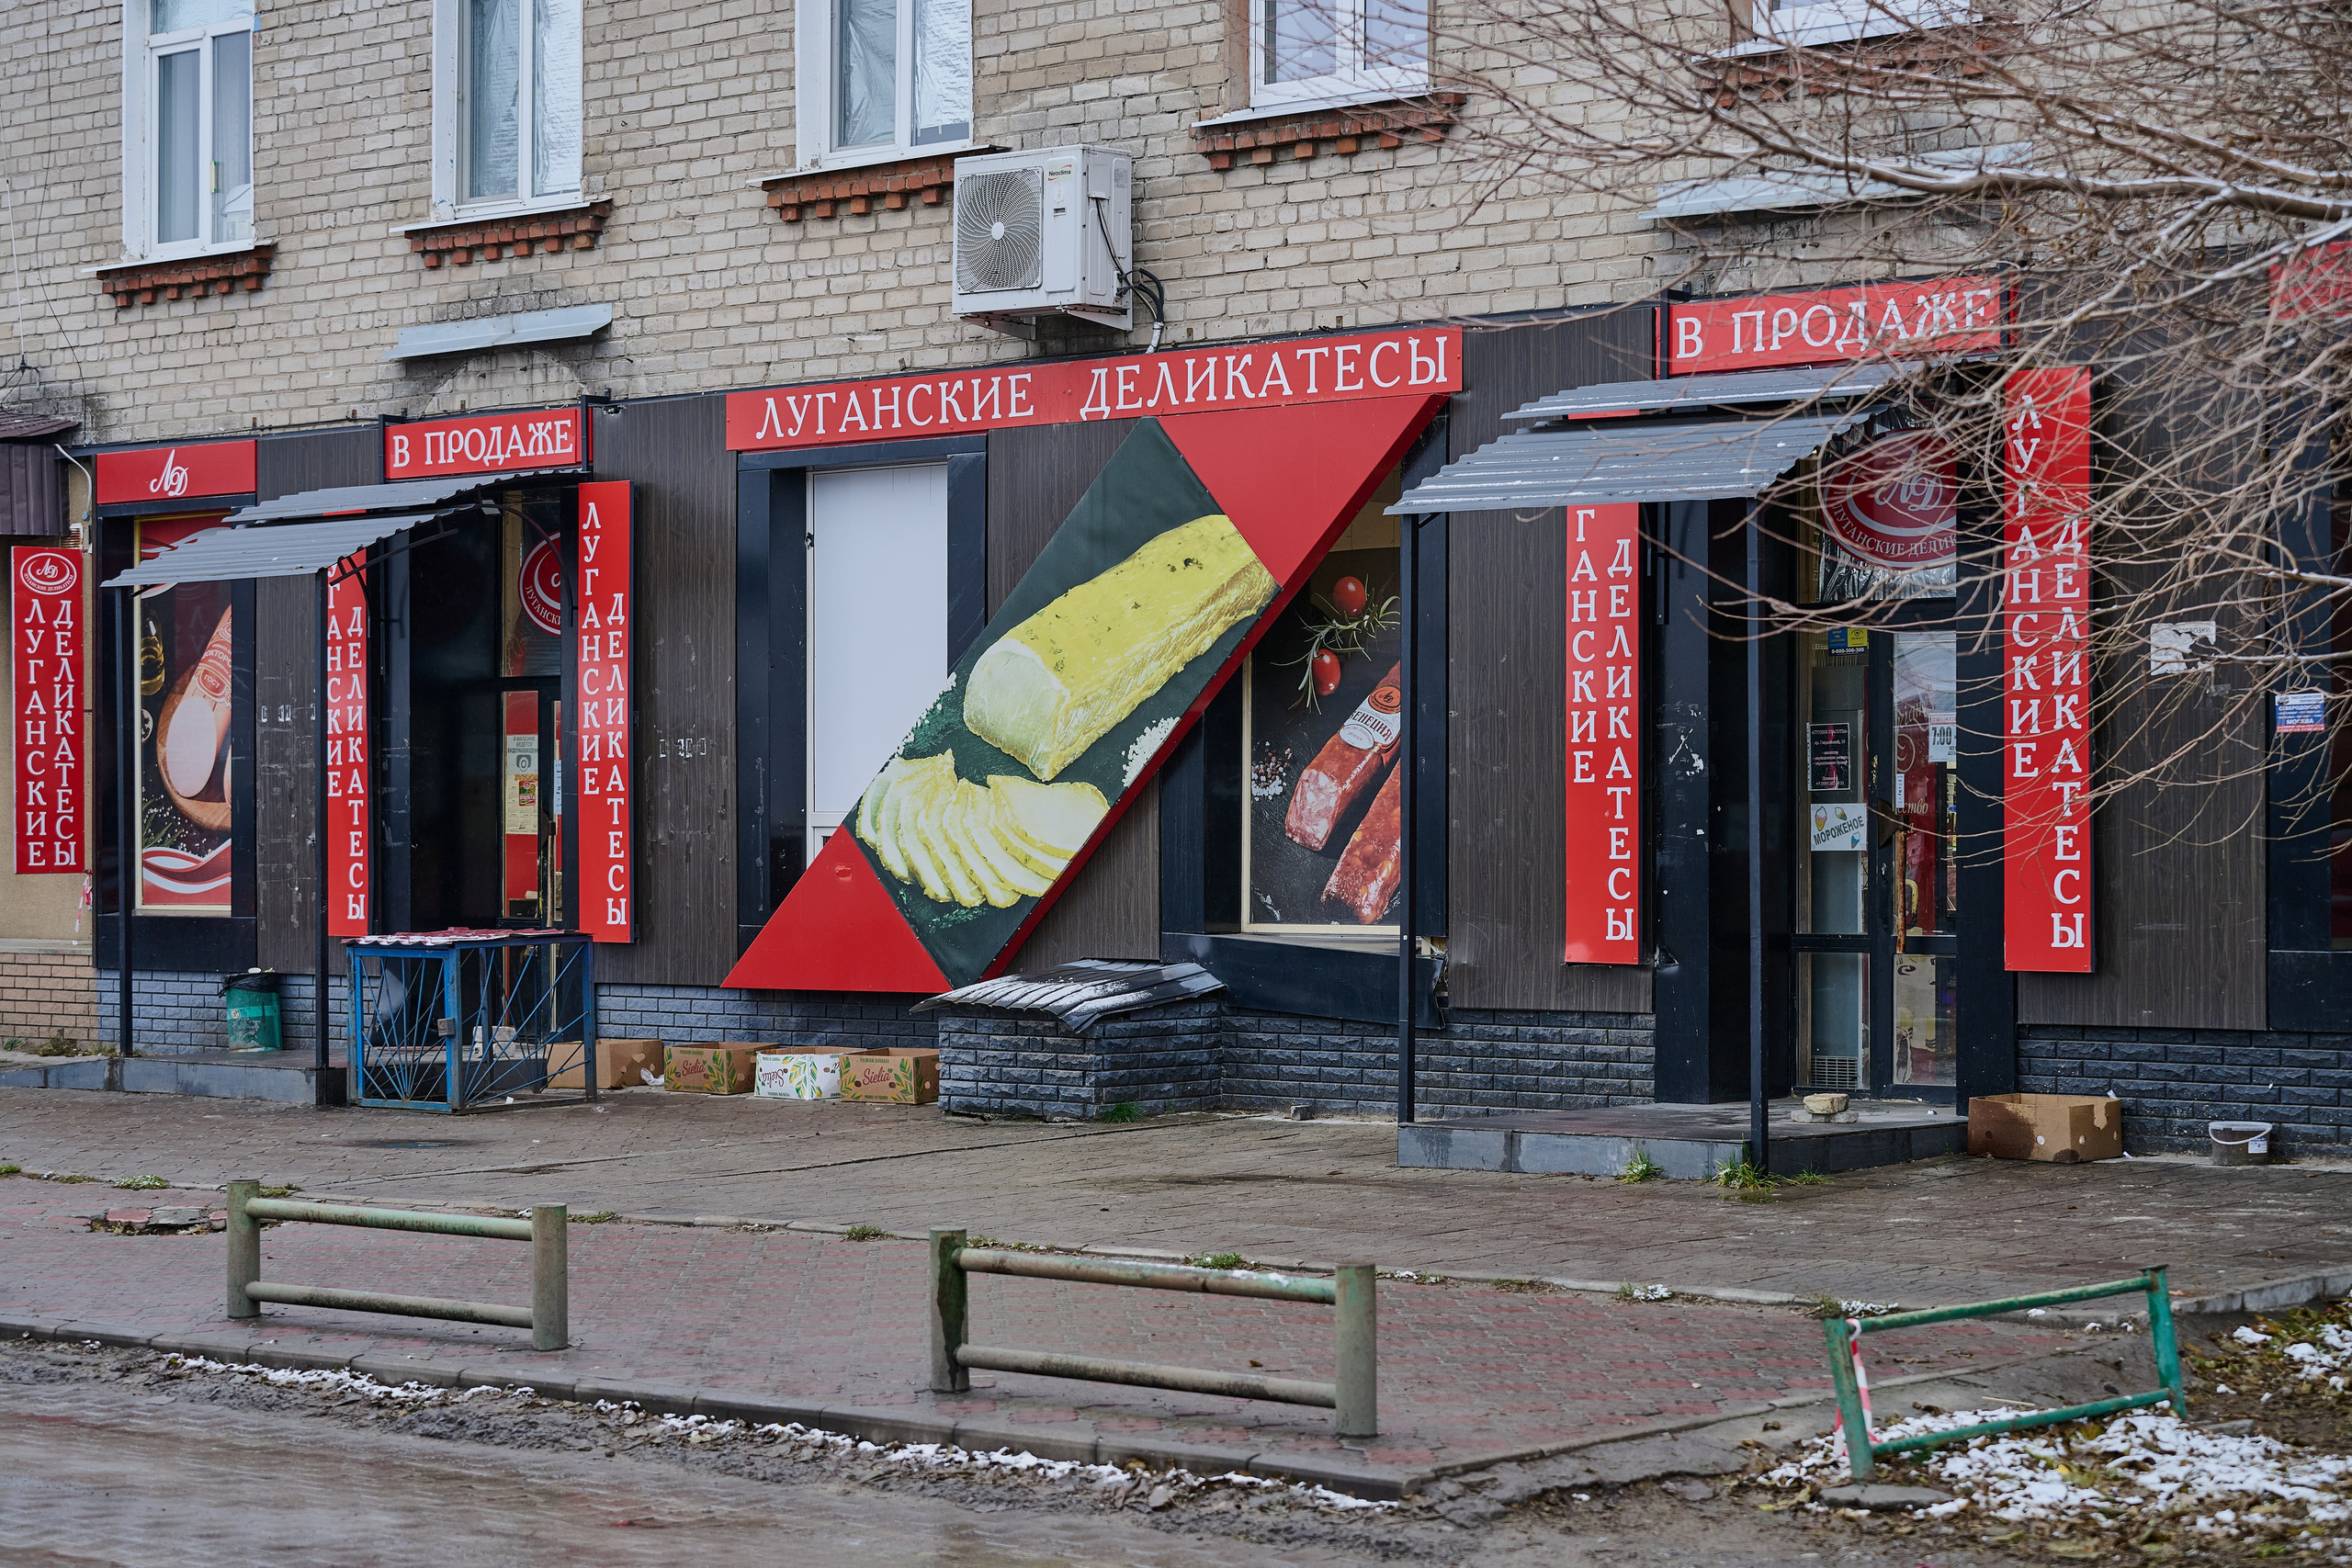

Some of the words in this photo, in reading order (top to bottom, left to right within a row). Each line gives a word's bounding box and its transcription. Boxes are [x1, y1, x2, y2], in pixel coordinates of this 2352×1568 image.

[1676, 317, 1702, 359] В
[1732, 288, 1994, 354] ПРОДАЖЕ
[756, 372, 1035, 441] ЛУГАНСКИЕ
[1080, 336, 1448, 421] ДЕЛИКАТЕСЫ
[393, 435, 410, 468] В
[424, 419, 573, 467] ПРОДАЖЕ
[1908, 533, 1956, 558] ДЕЛИК
[2010, 394, 2042, 777] ЛУГАНСКИЕ
[526, 585, 560, 626] ЛУГАНСК
[582, 502, 602, 795] ЛУГАНСКИЕ
[1570, 509, 1598, 784] ГАНСКИЕ
[25, 599, 47, 866] ЛУГАНСКИЕ
[53, 600, 76, 866] ДЕЛИКАТЕСЫ
[204, 674, 220, 689] ГОСТ
[2052, 514, 2085, 948] ДЕЛИКАТЕСЫ
[346, 606, 365, 919] ДЕЛИКАТЕСЫ
[606, 593, 628, 925] ДЕЛИКАТЕСЫ
[1605, 539, 1634, 941] ДЕЛИКАТЕСЫ
[1931, 727, 1951, 745] 7:00
[1814, 816, 1864, 845] МОРОЖЕНОЕ
[682, 1058, 706, 1077] Sielia
[863, 1066, 891, 1086] Sielia
